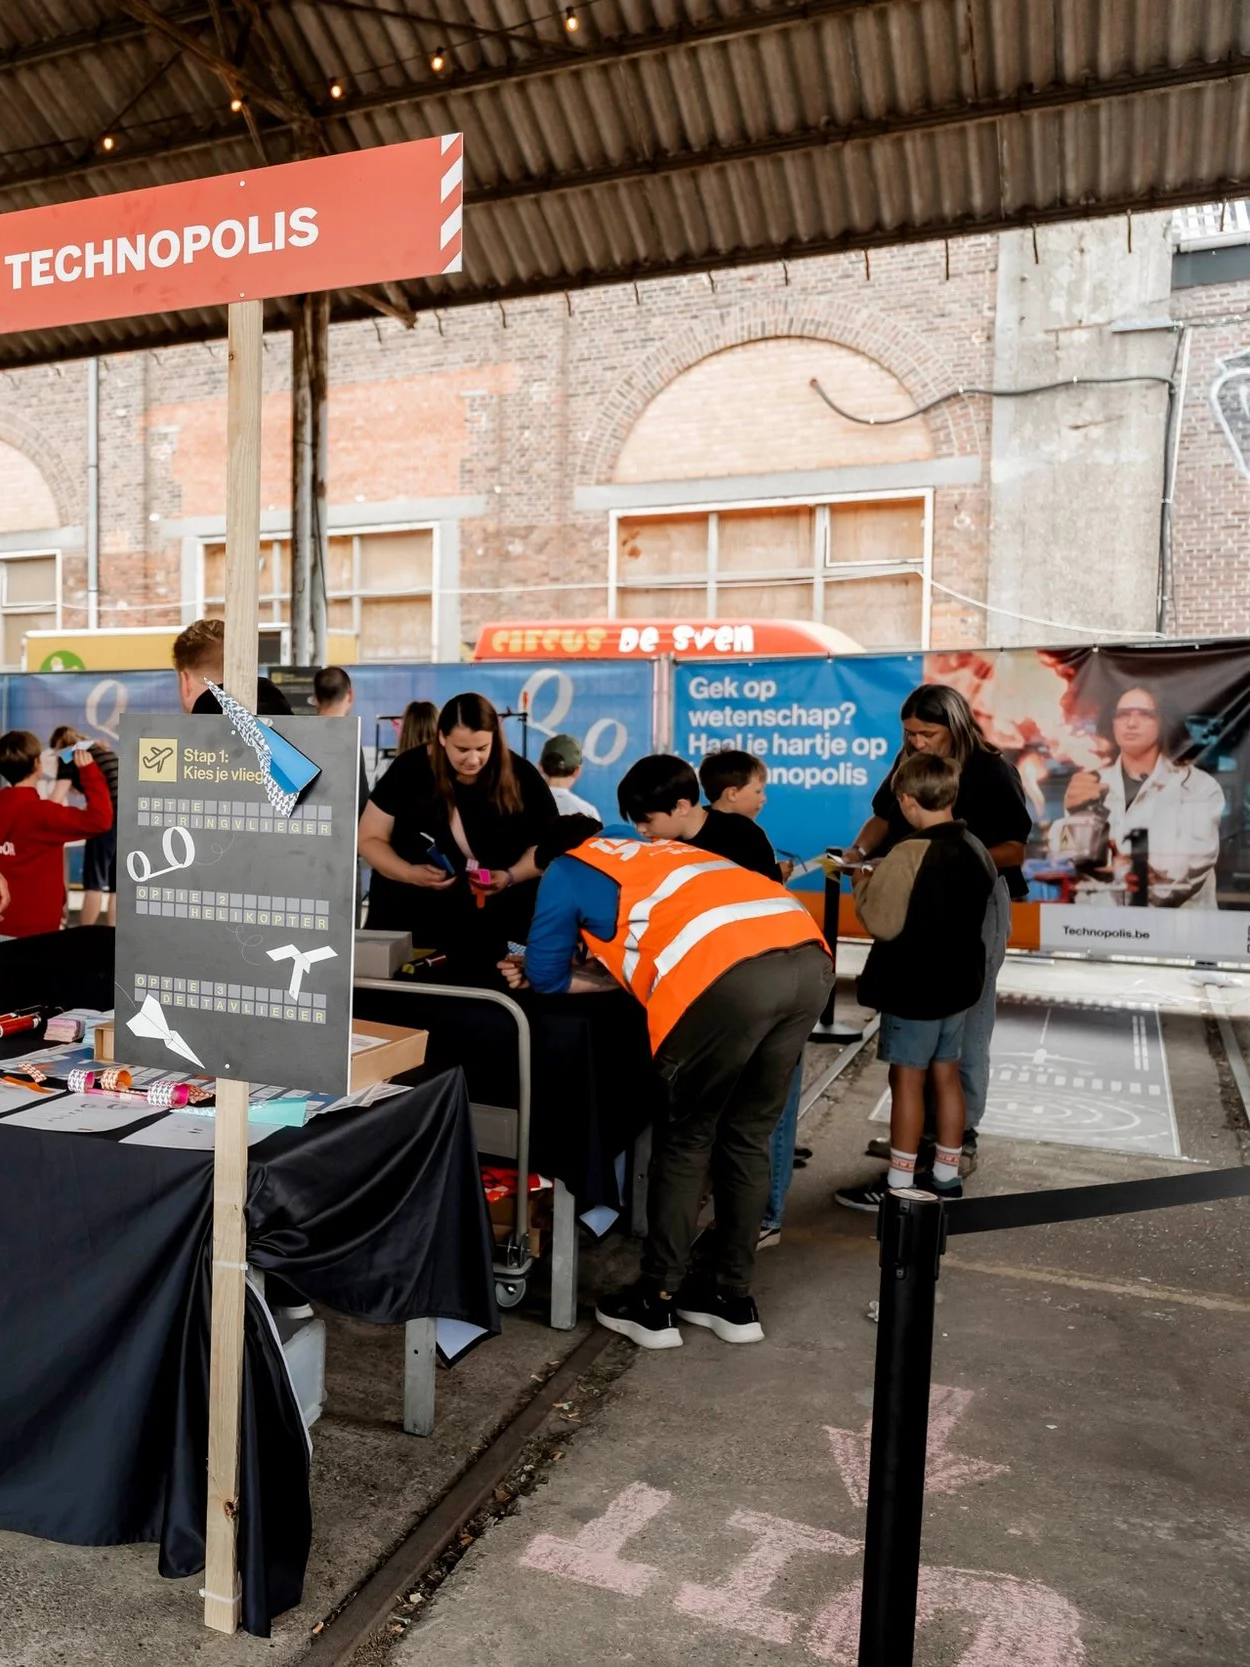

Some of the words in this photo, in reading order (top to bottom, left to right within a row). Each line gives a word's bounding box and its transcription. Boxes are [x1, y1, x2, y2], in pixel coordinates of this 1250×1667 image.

[4, 207, 318, 289] TECHNOPOLIS
[689, 676, 739, 700] Gek
[743, 679, 777, 702] op
[688, 702, 857, 730] wetenschap?
[773, 732, 847, 760] hartje
[852, 737, 887, 760] op
[183, 749, 217, 766] Stap
[219, 752, 229, 763] 1:
[183, 766, 214, 780] Kies
[215, 767, 228, 783] je
[231, 768, 265, 784] vlieg
[766, 762, 868, 789] nopolis
[140, 801, 201, 812] OPTIE
[138, 889, 199, 902] OPTIE
[219, 895, 226, 905] 2
[191, 908, 326, 929] HELIKOPTER
[1063, 925, 1150, 940] Technopolis.be
[137, 977, 197, 992] OPTIE
[217, 986, 224, 995] 3
[163, 994, 324, 1022] DELTAVLIEGER
